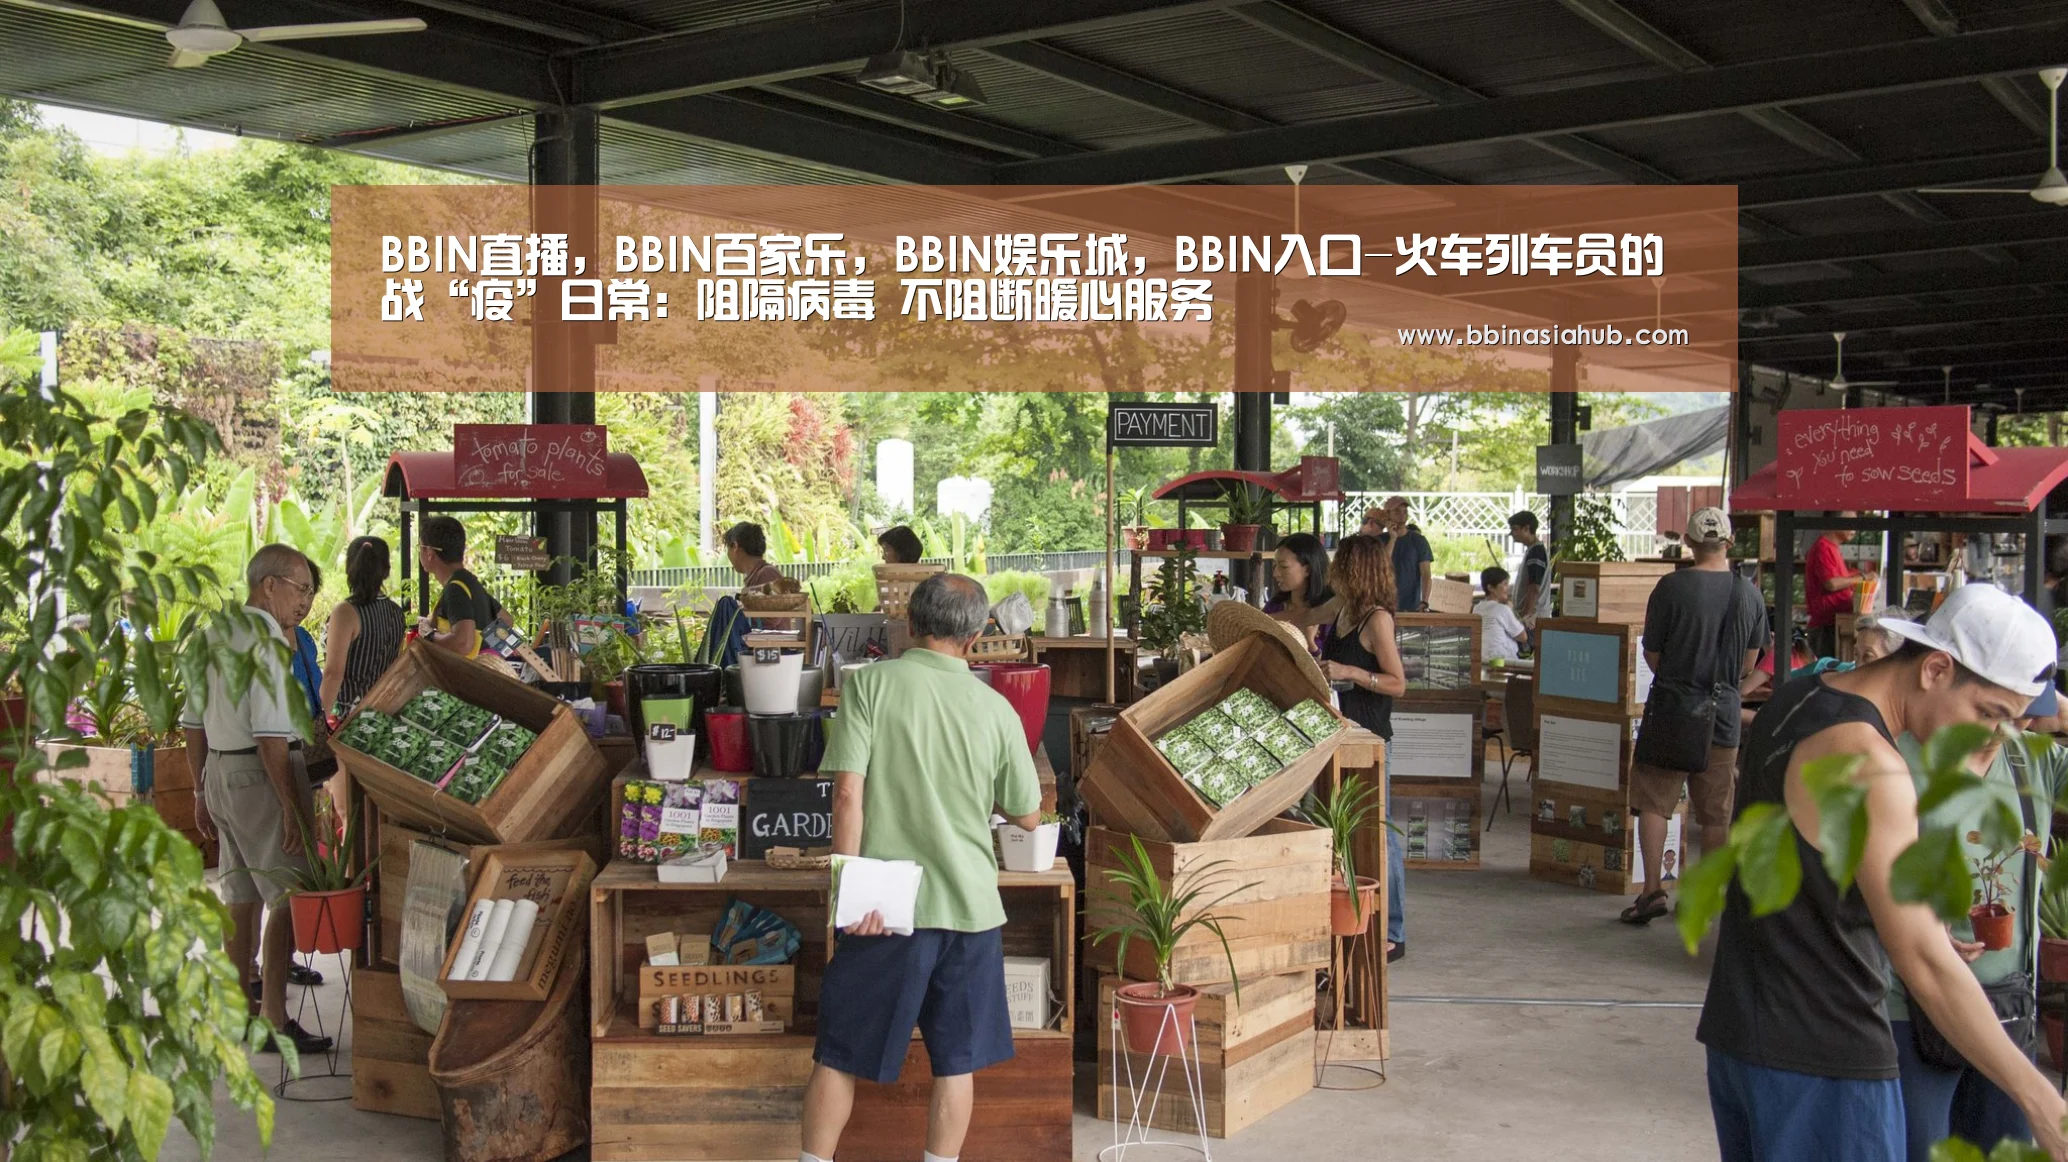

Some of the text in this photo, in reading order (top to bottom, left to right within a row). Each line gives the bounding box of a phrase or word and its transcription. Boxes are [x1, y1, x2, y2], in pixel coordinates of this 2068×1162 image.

[1117, 411, 1208, 437] PAYMENT
[1794, 415, 1880, 449] everything
[471, 428, 605, 476] tomato plants
[1840, 438, 1874, 465] need
[497, 462, 565, 484] for sale
[1834, 457, 1957, 488] to sow seeds
[756, 649, 779, 661] $15
[669, 810, 692, 819] 1001
[709, 806, 731, 815] 1001
[653, 969, 779, 988] SEEDLINGS
[1006, 981, 1034, 993] EEDS
[658, 1024, 703, 1033] SEED SAVERS
